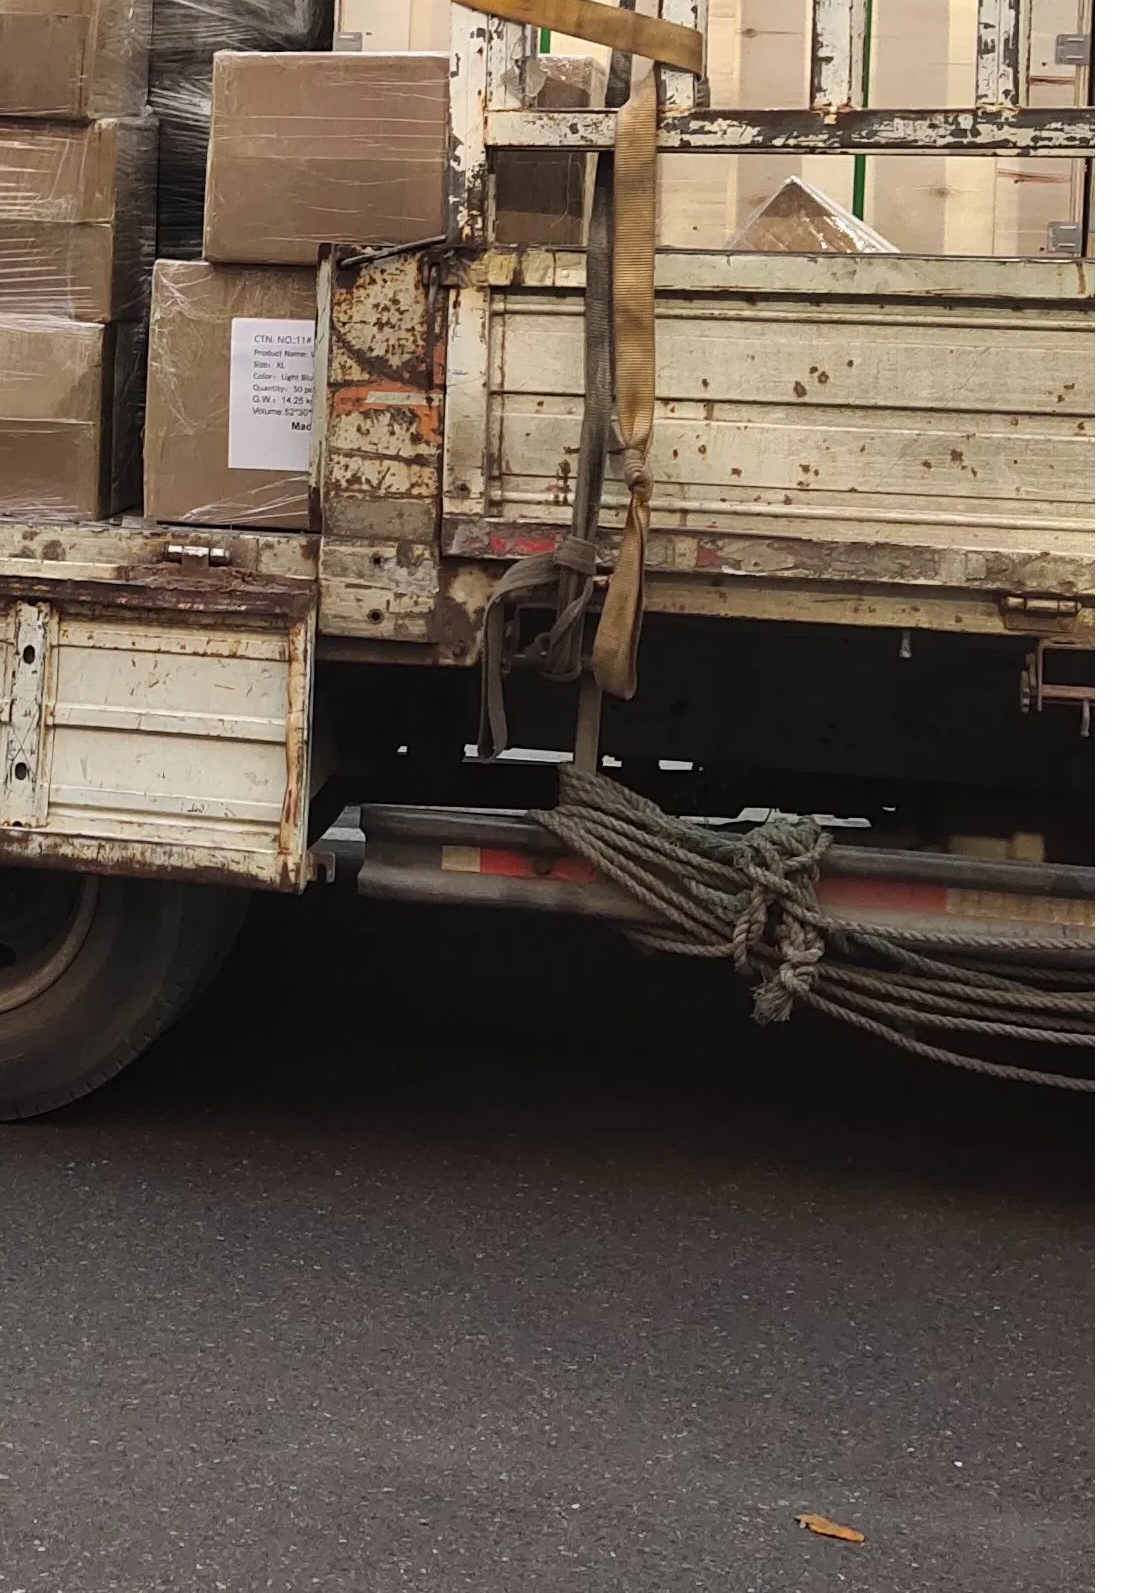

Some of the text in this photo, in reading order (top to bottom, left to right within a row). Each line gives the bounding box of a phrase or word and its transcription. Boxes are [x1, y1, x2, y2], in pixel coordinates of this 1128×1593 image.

[253, 349, 282, 357] Product
[275, 361, 285, 369] XL
[281, 373, 299, 382] Light
